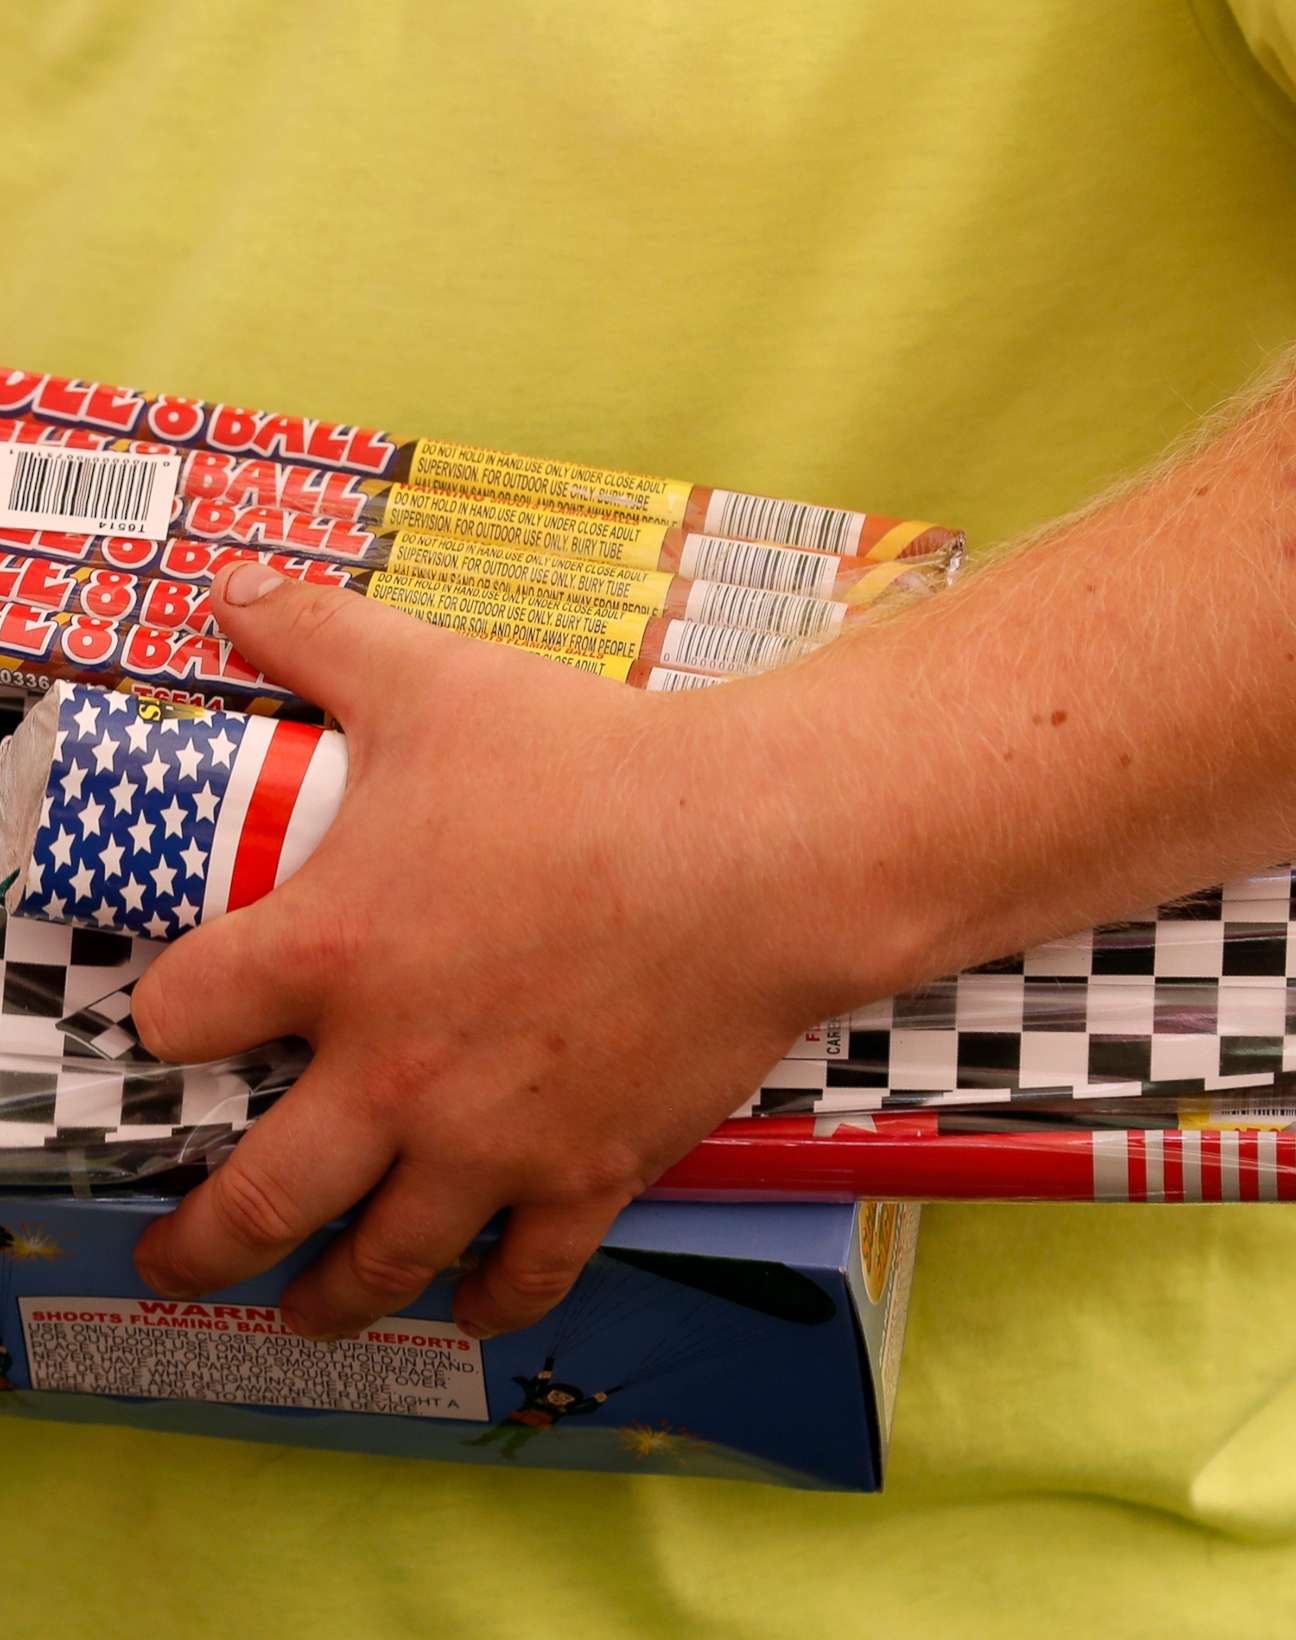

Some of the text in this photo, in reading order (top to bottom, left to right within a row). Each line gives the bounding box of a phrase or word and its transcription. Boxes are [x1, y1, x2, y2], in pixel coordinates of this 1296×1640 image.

[149, 396, 204, 441] 8
[207, 403, 397, 474] BALL
[188, 448, 367, 524] BALL
[99, 521, 146, 533] T6514
[188, 494, 374, 560] BALL
[394, 490, 411, 505] DO
[410, 493, 430, 508] NOT
[430, 496, 456, 513] HOLD
[458, 501, 468, 514] IN
[517, 510, 542, 527] ONLY
[543, 515, 575, 532] UNDER
[577, 520, 608, 537] CLOSE
[608, 525, 640, 543] ADULT
[454, 520, 473, 536] FOR
[475, 524, 519, 544] OUTDOOR
[522, 531, 540, 547] USE
[571, 538, 596, 555] BURY
[598, 542, 622, 559] TUBE
[81, 568, 137, 621] 8
[140, 578, 222, 639] BA
[437, 595, 457, 611] FOR
[459, 598, 503, 618] OUTDOOR
[506, 606, 524, 622] USE
[555, 613, 579, 630] BURY
[581, 617, 606, 635] TUBE
[61, 616, 118, 665] 8
[120, 624, 296, 694] BAL
[452, 614, 465, 629] OR
[490, 620, 511, 637] AND
[512, 624, 539, 642] POINT
[542, 629, 567, 647] AWAY
[569, 634, 596, 651] FROM
[597, 639, 634, 658] PEOPLE
[28, 1323, 65, 1333] USE
[72, 1324, 117, 1335] ONLY
[125, 1326, 189, 1340] UNDER
[195, 1331, 256, 1345] CLOSE
[262, 1335, 318, 1348] ADULT
[30, 1331, 67, 1342] FOR
[74, 1334, 166, 1350] OUTDOOR
[174, 1340, 209, 1352] USE
[299, 1349, 335, 1361] NOT
[343, 1352, 393, 1366] HOLD
[399, 1358, 417, 1369] IN
[32, 1312, 122, 1323] SHOOTS
[130, 1314, 229, 1331] FLAMING
[238, 1321, 292, 1335] BALL
[368, 1331, 471, 1350] REPORTS
[31, 1342, 89, 1353] PLACE
[97, 1344, 176, 1360] UPRIGHT
[185, 1351, 210, 1362] ON
[273, 1357, 353, 1372] SMOOTH
[33, 1351, 447, 1390] NEVER HAVE ANY PART OF YOUR BODY OVER
[34, 1360, 70, 1371] THE
[77, 1363, 142, 1377] DEVICE
[148, 1368, 204, 1381] WHEN
[209, 1371, 295, 1387] LIGHTING
[305, 1378, 337, 1389] THE
[36, 1370, 85, 1383] LIGHT
[95, 1374, 142, 1386] FUSE
[149, 1378, 186, 1390] AND
[192, 1382, 227, 1393] GET
[447, 1399, 460, 1409] A
